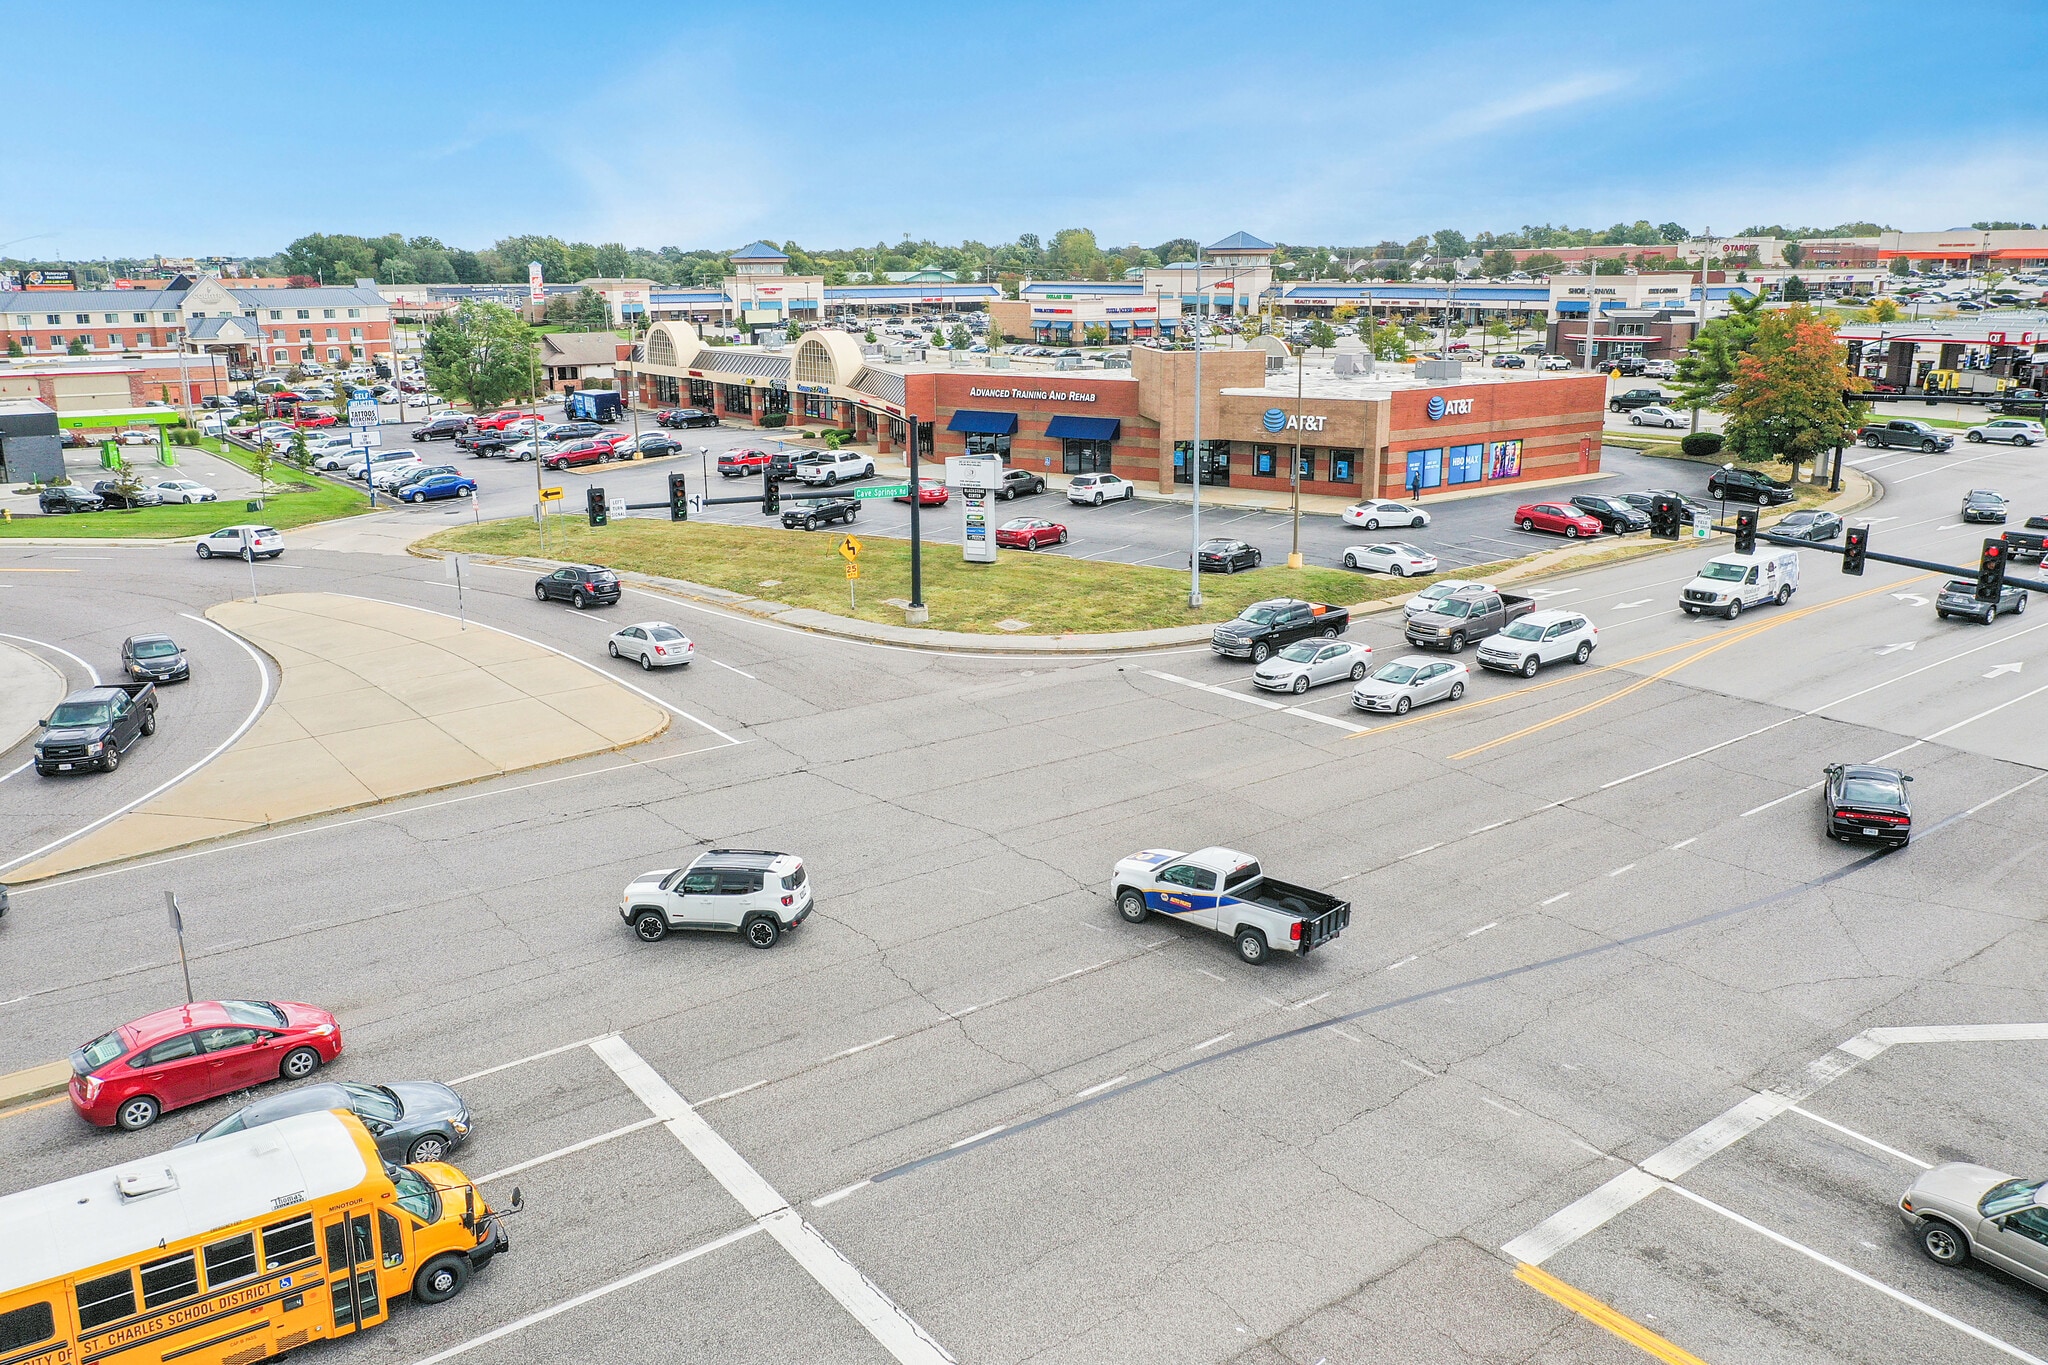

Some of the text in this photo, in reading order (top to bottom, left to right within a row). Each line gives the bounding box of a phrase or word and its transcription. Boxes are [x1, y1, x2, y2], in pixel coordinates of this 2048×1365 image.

[1990, 333, 2002, 343] QT
[354, 392, 369, 400] SELF
[969, 387, 1096, 402] ADVANCED TRAINING AND REHAB
[1445, 398, 1475, 416] AT&T
[351, 410, 376, 418] TATTOOS
[351, 415, 378, 423] PIERCINGS
[1286, 414, 1328, 431] AT&T
[1453, 455, 1479, 466] HBO MAX
[857, 489, 872, 498] Cave
[874, 488, 898, 497] Springs
[846, 564, 857, 573] 25
[271, 1190, 305, 1207] Thomas
[328, 1197, 364, 1212] MINOTOUR
[158, 1237, 166, 1250] 4
[58, 1347, 73, 1362] OF
[84, 1339, 104, 1353] ST.
[108, 1318, 164, 1346] CHARLES
[168, 1303, 215, 1326] SCHOOL
[219, 1283, 272, 1309] DISTRICT
